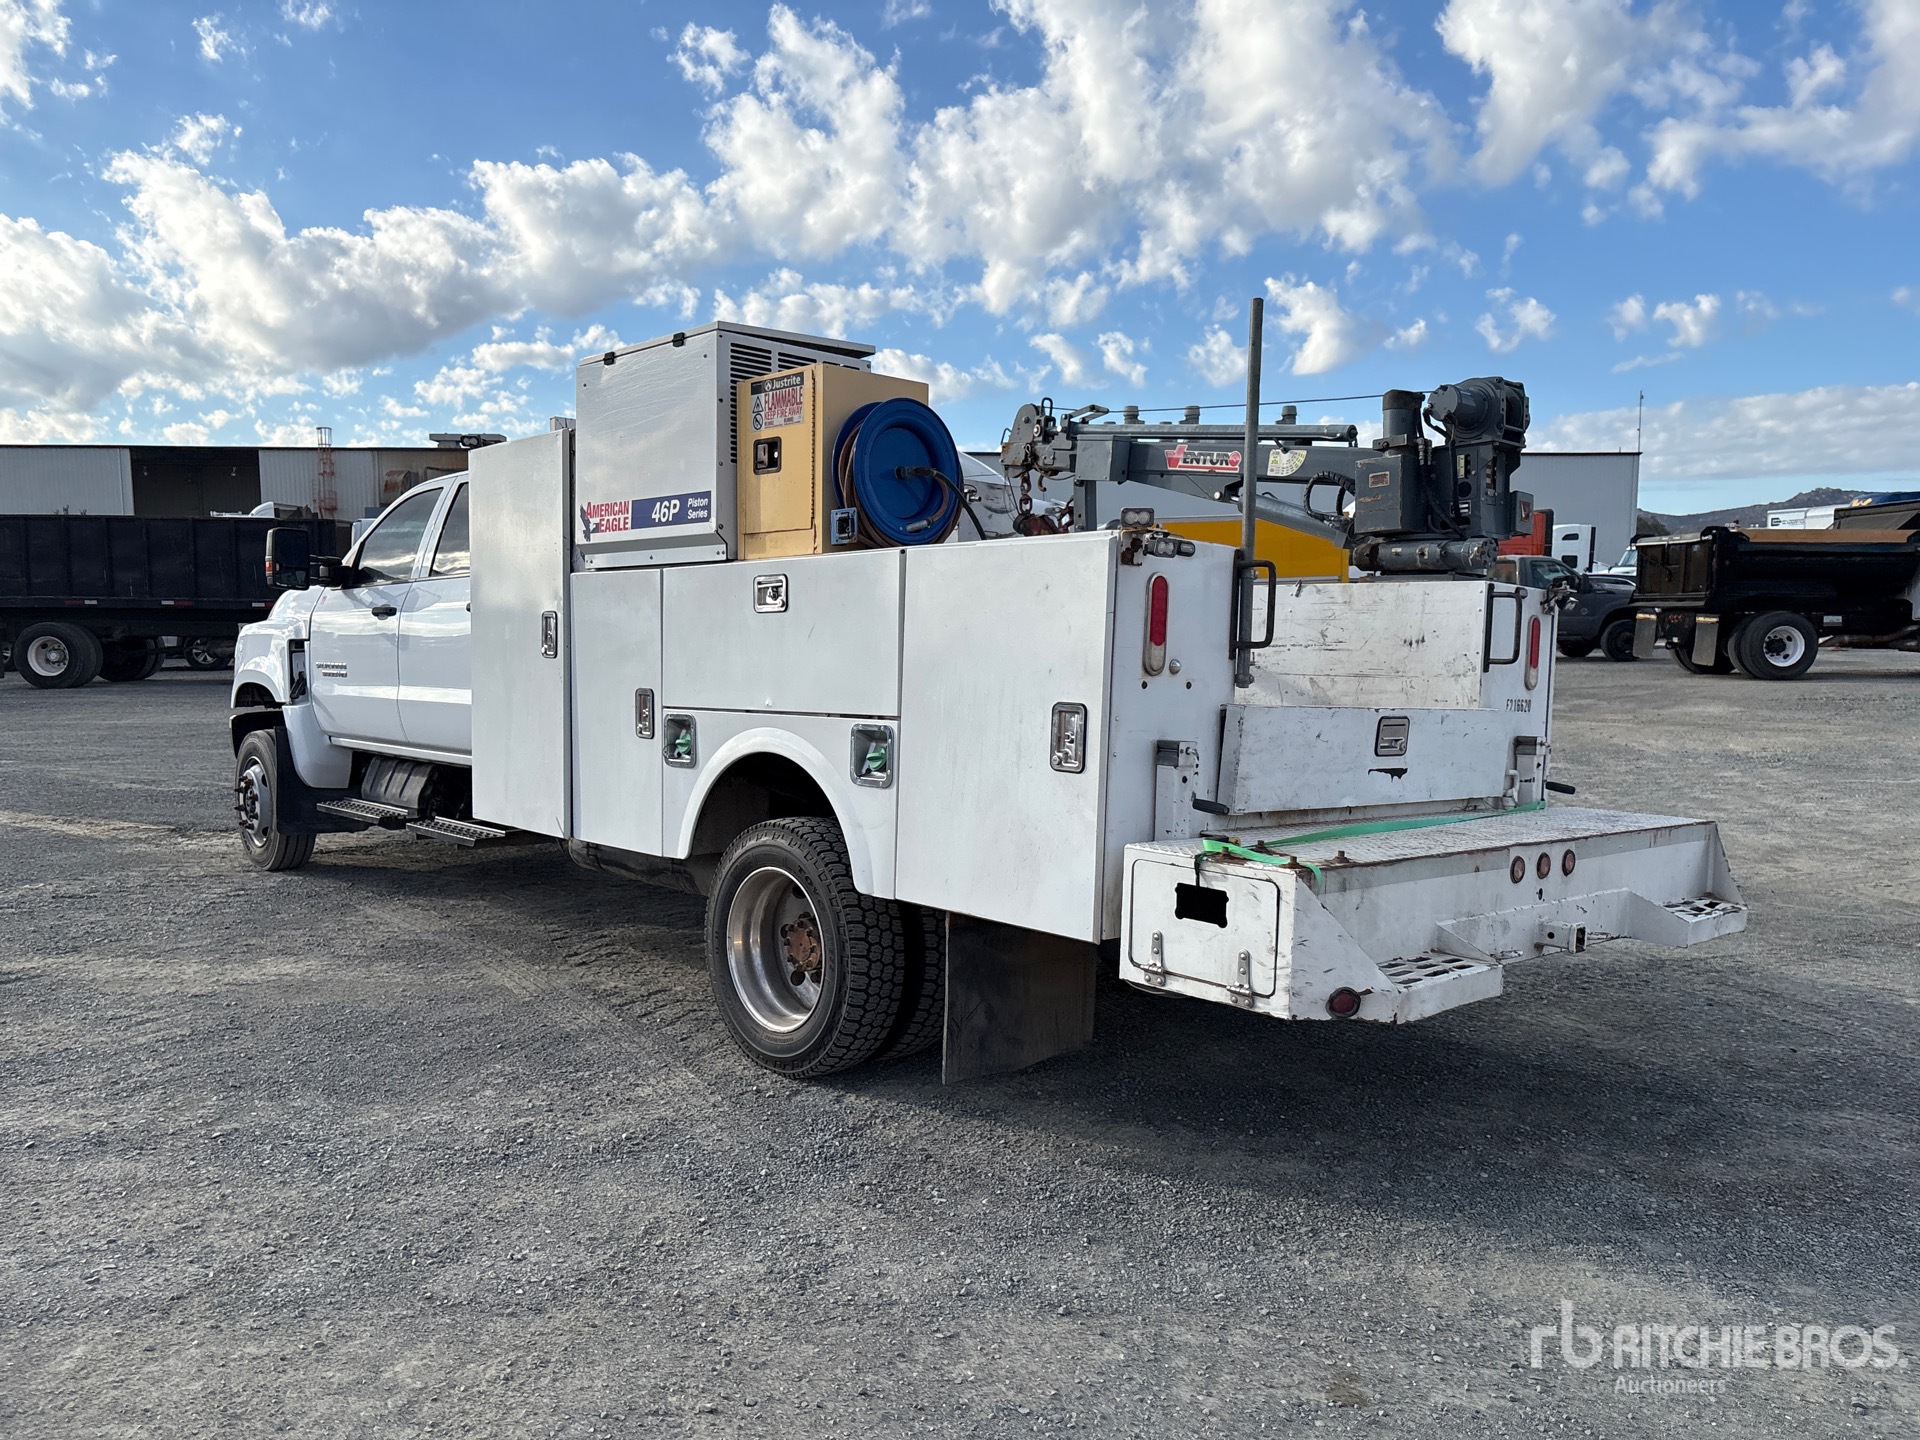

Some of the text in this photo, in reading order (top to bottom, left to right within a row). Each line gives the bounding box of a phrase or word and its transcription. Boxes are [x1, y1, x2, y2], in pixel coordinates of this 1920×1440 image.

[772, 375, 801, 390] Justrite
[764, 386, 803, 411] FLAMMABLE
[764, 411, 777, 420] KEEP
[788, 405, 803, 416] AWAY
[1164, 444, 1242, 471] VENTURO
[585, 501, 630, 519] AMERICAN
[651, 499, 681, 523] 46P
[687, 498, 708, 508] Piston
[687, 508, 709, 520] Series
[598, 517, 629, 533] EAGLE
